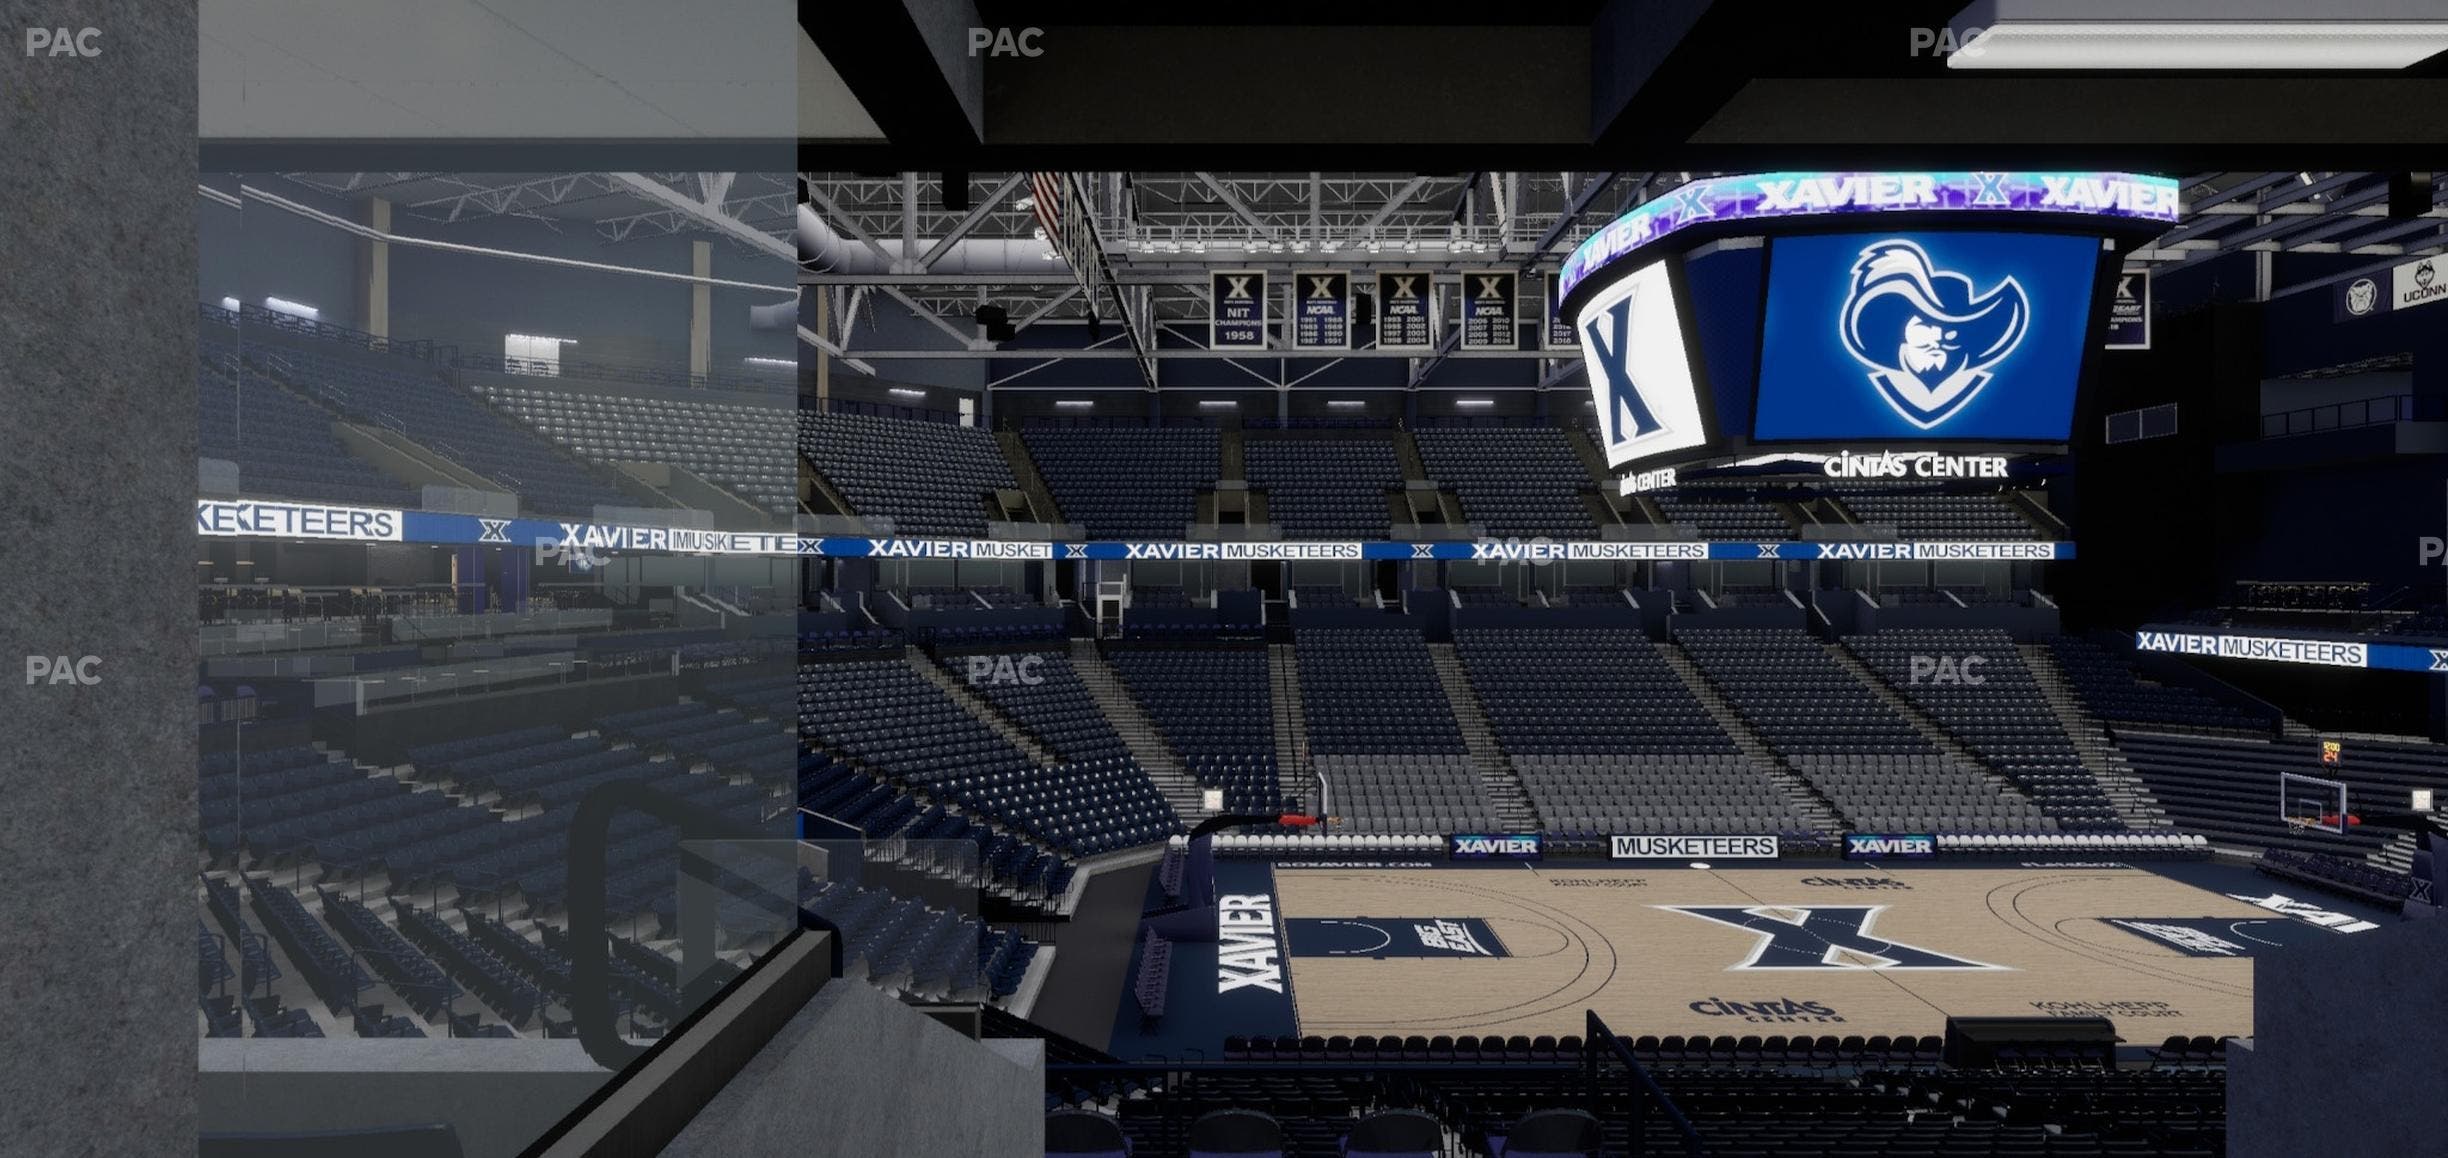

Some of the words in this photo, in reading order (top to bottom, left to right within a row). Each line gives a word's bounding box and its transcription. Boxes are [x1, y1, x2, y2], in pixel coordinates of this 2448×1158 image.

[1583, 213, 1652, 273] XAVIER
[1756, 175, 1937, 210] XAVIER
[2040, 175, 2179, 214] XAVIER
[1226, 276, 1253, 299] X
[1310, 276, 1335, 299] X
[1393, 277, 1418, 299] X
[1477, 277, 1504, 299] X
[2404, 284, 2447, 303] UCONN
[1227, 308, 1250, 318] NIT
[1306, 306, 1335, 315] NCAA
[1390, 305, 1418, 315] NCAA
[1475, 307, 1504, 316] NCAA
[1225, 331, 1255, 340] 1958
[1585, 293, 1664, 445] X
[1914, 457, 2009, 477] CENTER
[1638, 468, 1677, 492] CENTER
[559, 523, 669, 550] XAVIER
[868, 539, 969, 558] XAVIER
[976, 544, 1051, 558] MUSKET
[1125, 543, 1220, 559] XAVIER
[1227, 544, 1358, 558] MUSKETEERS
[1471, 543, 1566, 559] XAVIER
[1573, 544, 1704, 558] MUSKETEERS
[1818, 543, 1913, 559] XAVIER
[1919, 544, 2050, 558] MUSKETEERS
[2137, 631, 2217, 654] XAVIER
[2223, 637, 2362, 664] MUSKETEERS
[1455, 839, 1538, 854] XAVIER
[1617, 838, 1775, 855] MUSKETEERS
[1850, 839, 1933, 854] XAVIER
[1218, 893, 1283, 994] XAVIER
[1745, 1015, 1848, 1023] CENTER
[2118, 1010, 2186, 1018] COURT
